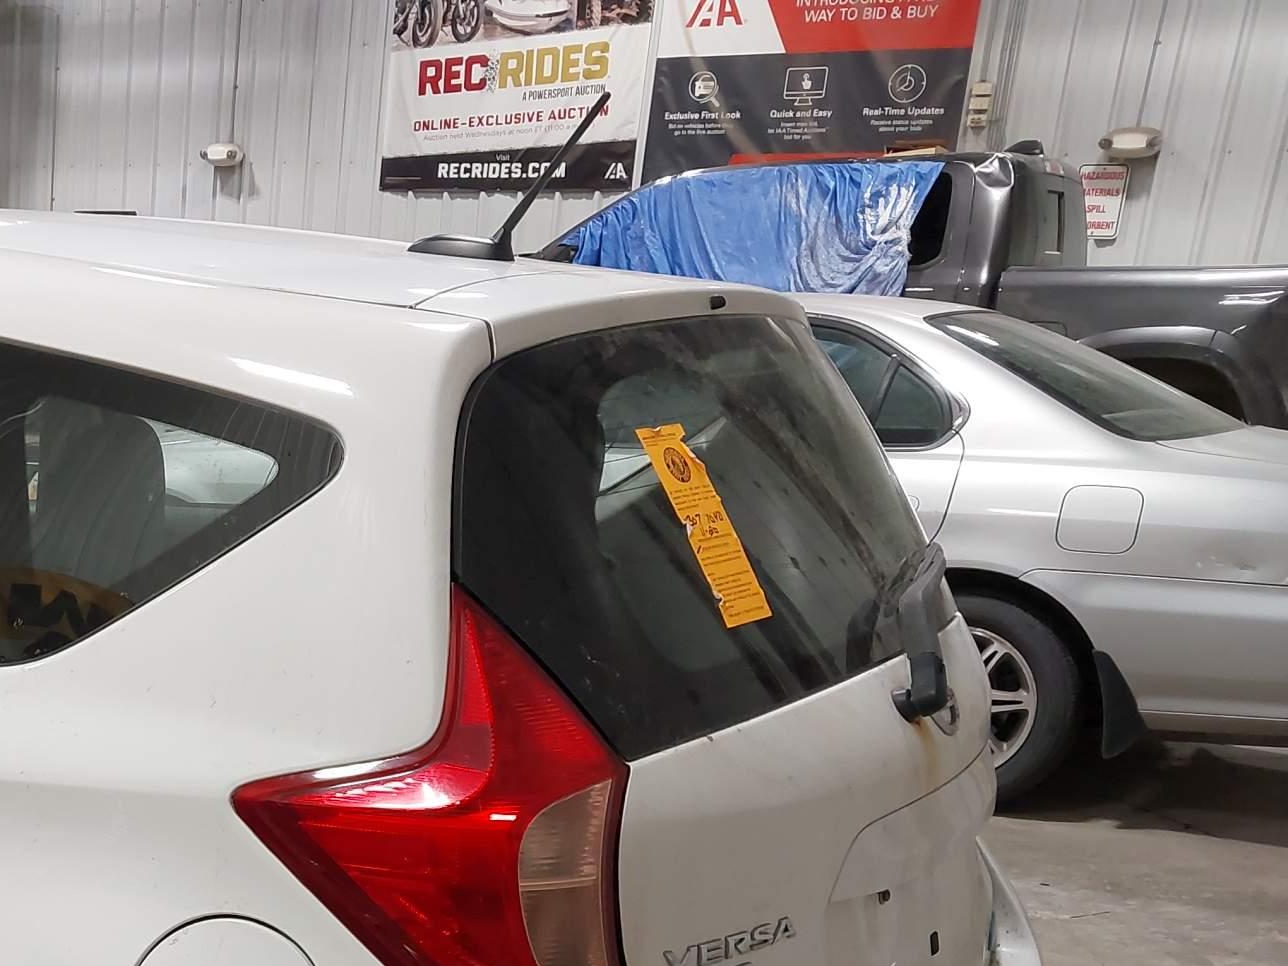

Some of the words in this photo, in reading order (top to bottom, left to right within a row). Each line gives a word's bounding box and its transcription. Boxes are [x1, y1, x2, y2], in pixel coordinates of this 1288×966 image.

[804, 8, 835, 23] WAY
[840, 7, 858, 21] TO
[863, 6, 887, 20] BID
[891, 6, 902, 19] &
[906, 4, 939, 18] BUY
[418, 54, 490, 96] REC
[498, 41, 610, 89] RIDES
[522, 92, 527, 101] A
[528, 87, 573, 100] POWERSPORT
[575, 83, 606, 97] AUCTION
[664, 111, 700, 120] Exclusive
[701, 110, 719, 119] First
[770, 109, 794, 118] Quick
[795, 109, 812, 118] and
[812, 108, 833, 118] Easy
[862, 107, 906, 116] Real-Time
[907, 106, 945, 117] Updates
[413, 110, 543, 132] ONLINE-EXCLUSIVE
[548, 105, 609, 121] AUCTIN
[495, 153, 510, 161] Visit
[1084, 188, 1120, 197] ATERIALS
[1086, 204, 1106, 213] SPILL
[1087, 221, 1115, 230] ORBENT
